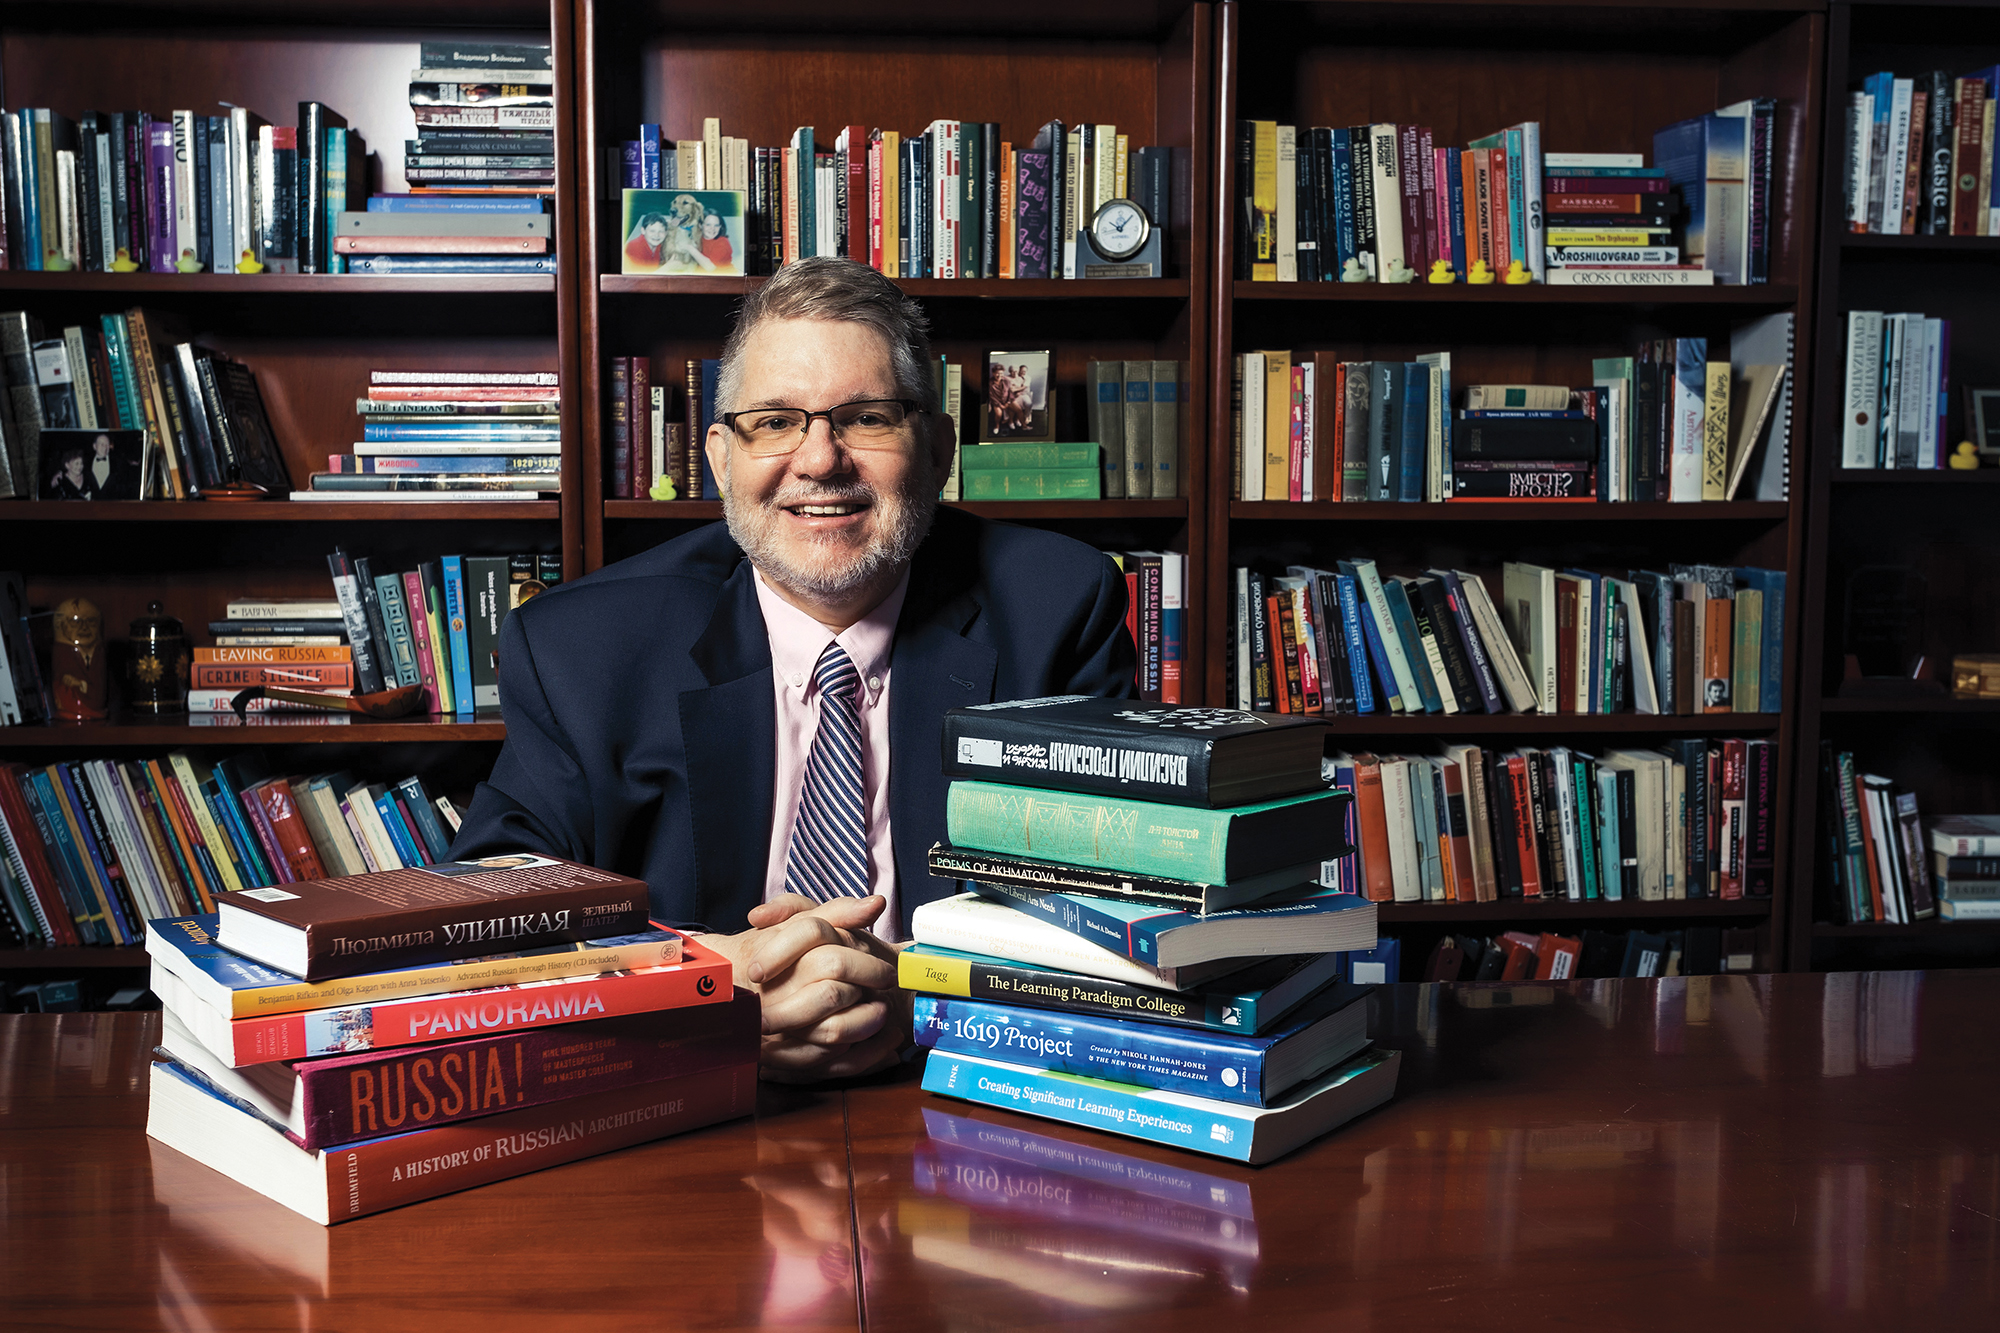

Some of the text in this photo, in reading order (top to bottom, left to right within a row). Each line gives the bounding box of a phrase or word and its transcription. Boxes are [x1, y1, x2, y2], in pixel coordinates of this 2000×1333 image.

[1911, 101, 1925, 163] LOVE FROM
[1935, 87, 1946, 136] Wilkerson
[419, 156, 444, 166] RUSSIAN
[419, 169, 487, 178] RUSSIAN CINEMA READER
[1116, 137, 1125, 174] The Petty
[1384, 135, 1392, 177] RUSSIAN
[1402, 132, 1413, 196] RUSSIAN LITERATURE
[1409, 126, 1420, 196] LATE POST-SOVIET
[1892, 110, 1907, 210] SEEING RACE AGAIN
[836, 155, 846, 207] TURGENEV
[1066, 152, 1075, 241] LIMITS TO INTERPRETATION
[1362, 152, 1374, 239] ANTHOLOGY RUSSIAN
[1479, 168, 1489, 229] MAJOR SOVIET
[1932, 147, 1952, 208] Caste
[1000, 179, 1009, 223] TOLSTOY
[1552, 251, 1641, 262] VOROSHILOVGRAD
[1595, 234, 1639, 244] The Orphanage
[1572, 272, 1688, 284] CROSS CURRENTS 8
[1851, 316, 1866, 410] CIVILIZATION
[1864, 333, 1878, 411] EMPATHIC
[393, 404, 455, 413] ITINERANTS
[377, 459, 420, 469] ЖИВОПИСЬ
[1509, 473, 1562, 487] ВМЕСТЕ
[261, 607, 278, 616] YAR
[447, 578, 458, 617] SHTETL
[1149, 568, 1159, 692] CONSUMING RUSSIA
[1416, 616, 1445, 676] ЛОЛИТА
[212, 648, 327, 662] LEAVING RUSSIA
[206, 670, 250, 684] CRIME
[1049, 741, 1188, 787] ВАСИЛИЙ ГРОССМАН
[71, 766, 104, 842] Beginner's Russian
[1473, 761, 1488, 821] PETERSBURG
[1695, 752, 1705, 863] SVETLANA ALEXIEVICH
[1534, 803, 1545, 834] CEMENT
[1756, 807, 1769, 852] WINTER
[1160, 838, 1184, 850] АННА
[936, 857, 1057, 884] POEMS OF AKHMATOVA
[582, 901, 633, 916] ЗЕЛЕНЫЙ
[1008, 885, 1056, 914] Liberal Arts Needs
[330, 909, 570, 957] Людмила УЛИЦКАЯ
[582, 914, 620, 928] ШАТЕР
[1086, 919, 1100, 931] Richard
[917, 922, 1141, 970] TWELVE STEPS TO COMPASSIONATE KAREN ARMSTRONG
[258, 954, 620, 1005] Benjamin Rifkin and Olga Kagan with Anna Yatsenko Advanced Russian through History (CD included)
[925, 966, 949, 984] Tagg
[987, 974, 1186, 1015] The Learning Paradigm College
[409, 989, 605, 1038] PANORAMA
[542, 1037, 616, 1059] NINE HUNDRED YEARS
[927, 1015, 1074, 1057] The 1619 Project
[1090, 1044, 1148, 1061] Created by NIKOLE
[553, 1053, 605, 1070] MASTERPIECES
[559, 1060, 633, 1082] MASTER COLLECTIONS
[947, 1064, 959, 1089] FINK
[1095, 1056, 1209, 1082] THE NEW YORK TIMES MAGAZINE
[350, 1042, 524, 1134] RUSSIA!
[977, 1076, 1193, 1135] Creating Significant Learning Experiences
[391, 1098, 684, 1183] A HISTORY OF RUSSIAN ARCHITECTURE
[347, 1152, 360, 1214] BRUMFIELD
